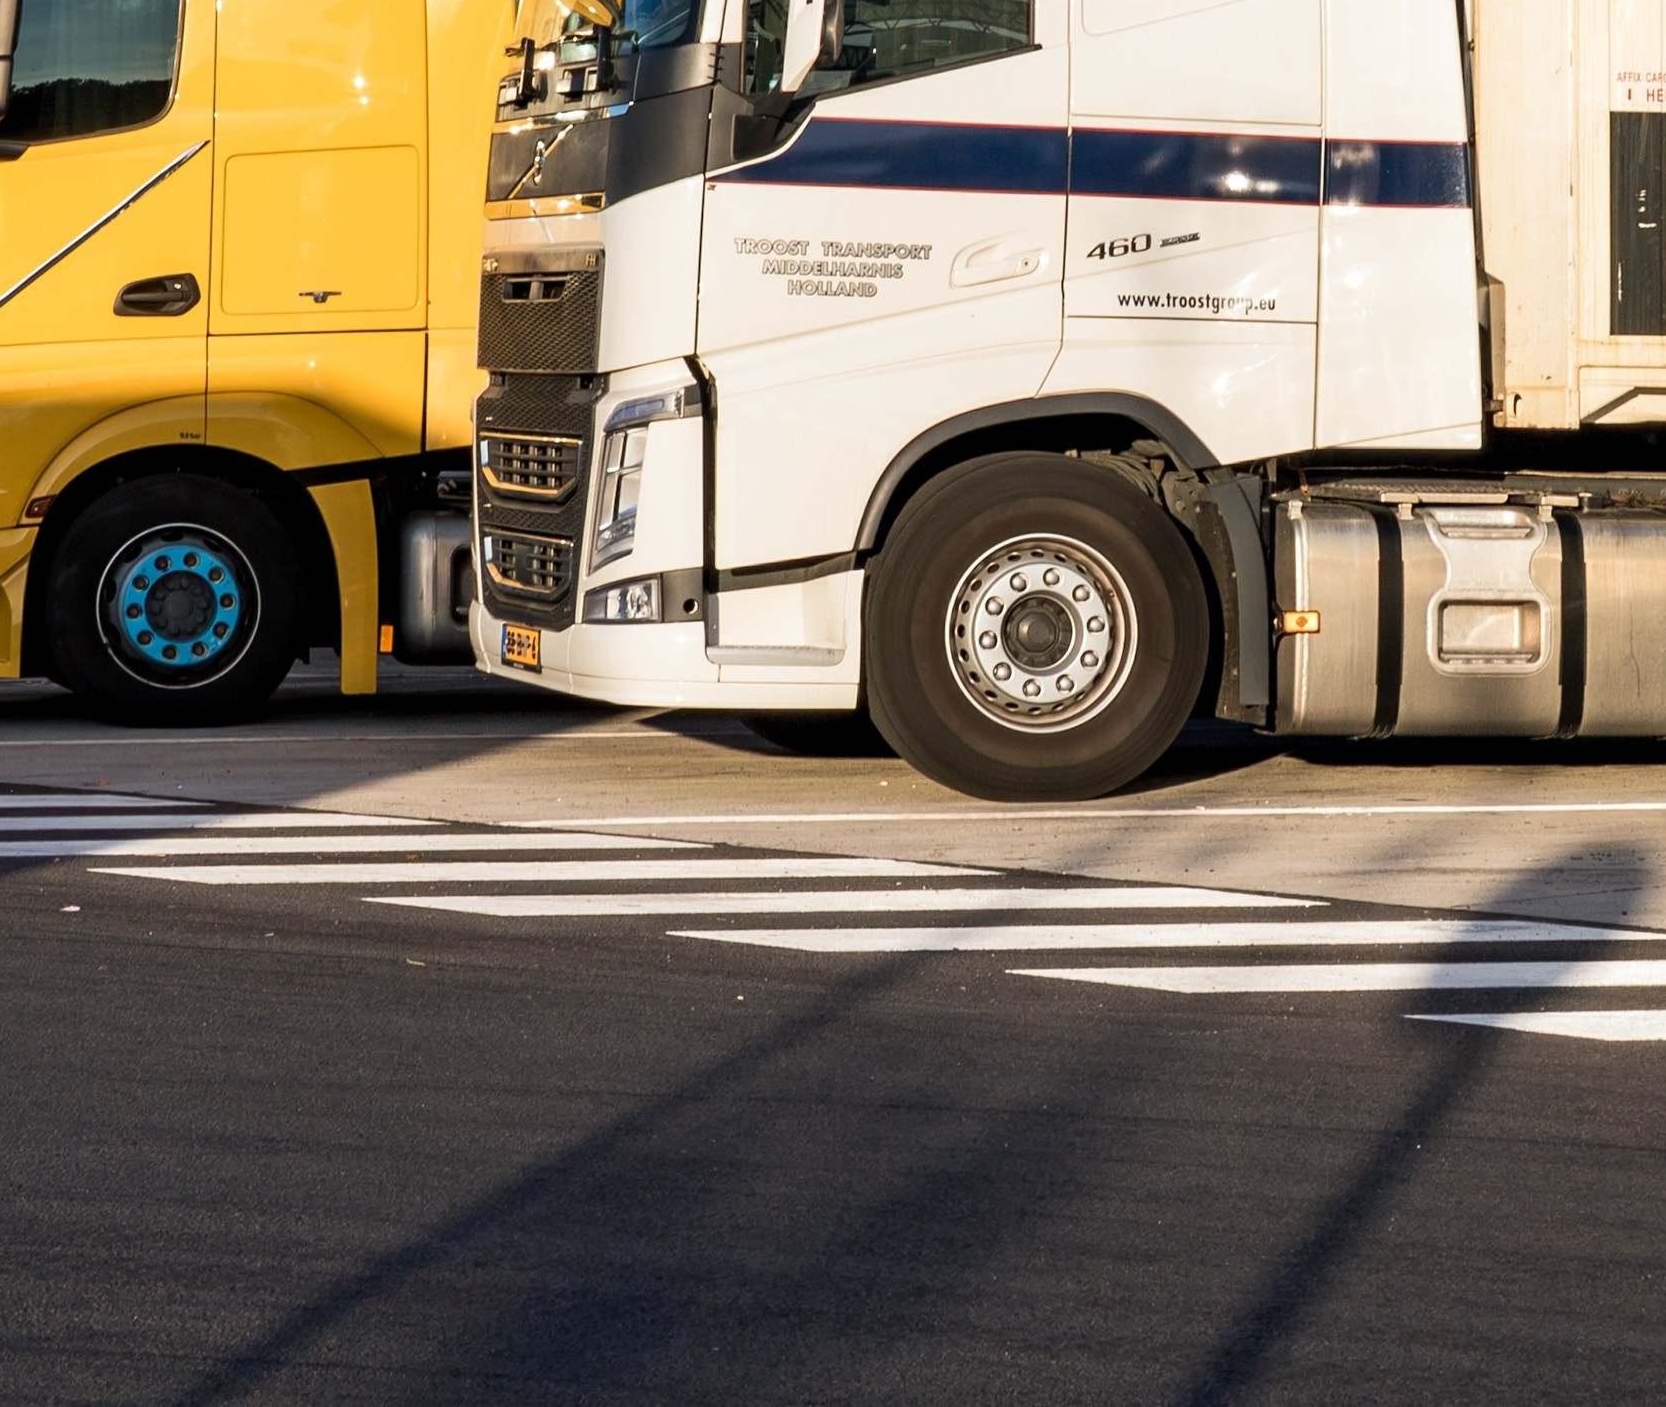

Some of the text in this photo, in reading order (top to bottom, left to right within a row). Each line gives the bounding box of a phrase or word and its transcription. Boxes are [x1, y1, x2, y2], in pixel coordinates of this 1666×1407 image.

[1617, 71, 1642, 83] AFFIX
[734, 237, 933, 261] TROOST TRANSPORT
[1086, 233, 1152, 260] 460
[762, 258, 904, 279] MIDDELHARNIS
[787, 279, 878, 298] HOLLAND
